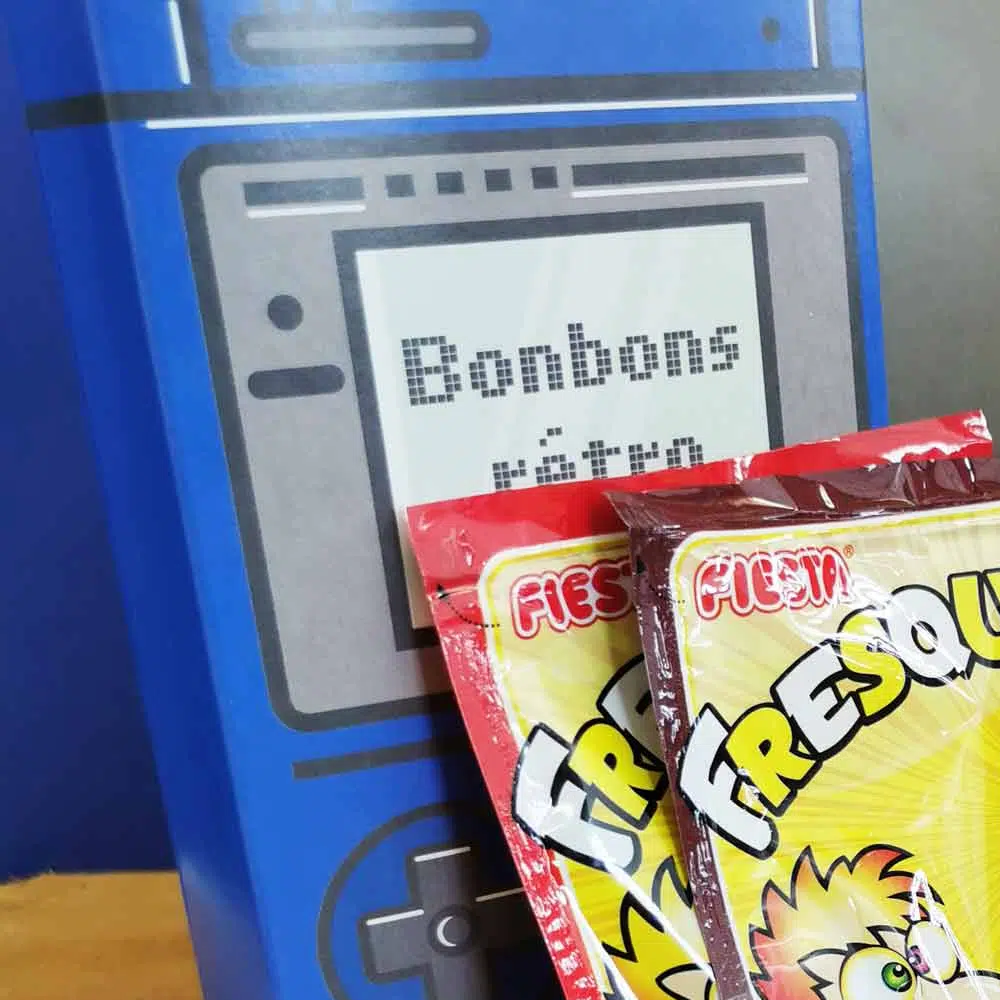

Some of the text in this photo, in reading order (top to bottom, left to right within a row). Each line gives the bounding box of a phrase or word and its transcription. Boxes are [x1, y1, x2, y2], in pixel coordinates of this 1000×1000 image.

[401, 322, 740, 406] Bonbons
[511, 556, 637, 639] FIES
[694, 545, 851, 620] FIESTA
